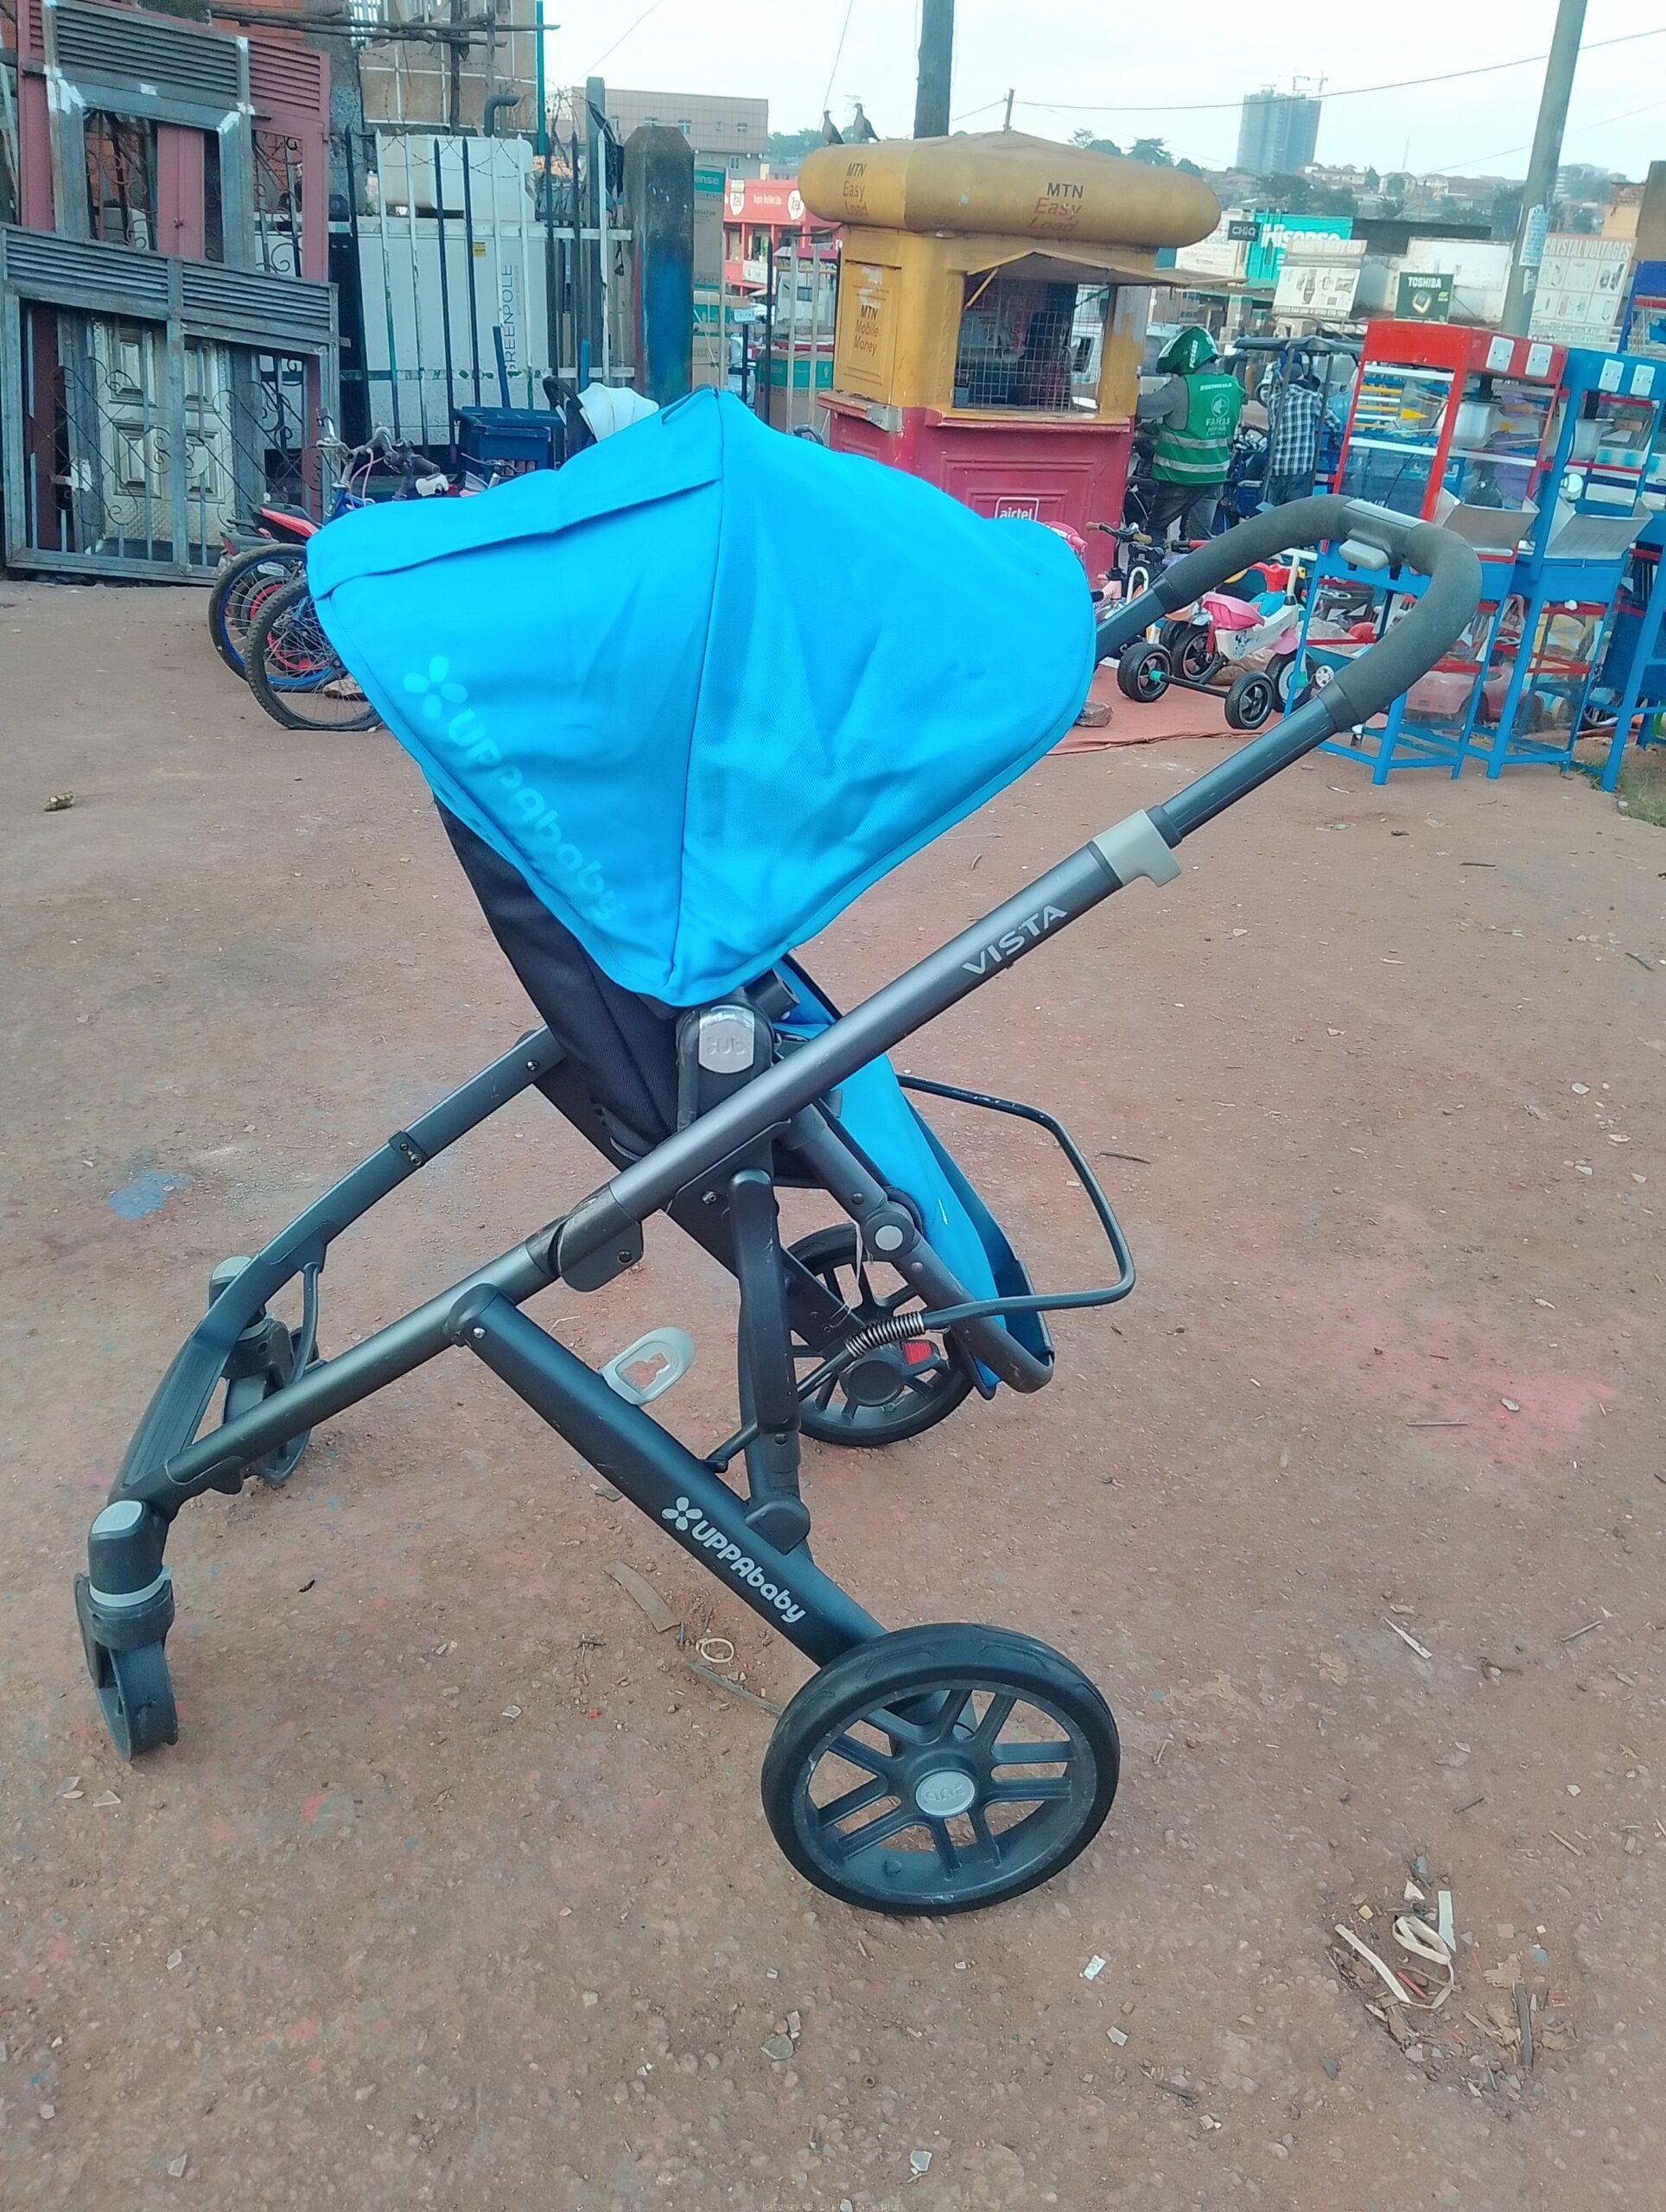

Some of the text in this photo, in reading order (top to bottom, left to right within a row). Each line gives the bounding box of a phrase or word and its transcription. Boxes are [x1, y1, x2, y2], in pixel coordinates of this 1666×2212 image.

[846, 162, 867, 178] MTN
[843, 180, 865, 202] Easy
[1046, 182, 1084, 200] MTN
[1033, 196, 1082, 220] Easy
[1027, 217, 1079, 232] Load
[1543, 238, 1632, 260] CRYSTAL VOLTAGES
[1408, 276, 1442, 289] TOSHIBA
[860, 304, 879, 321] MTN
[855, 319, 880, 338] Mobile
[853, 335, 878, 357] Money
[999, 506, 1033, 519] airtel
[960, 905, 1068, 975] VISTA
[692, 1520, 806, 1624] UPPAbaby
